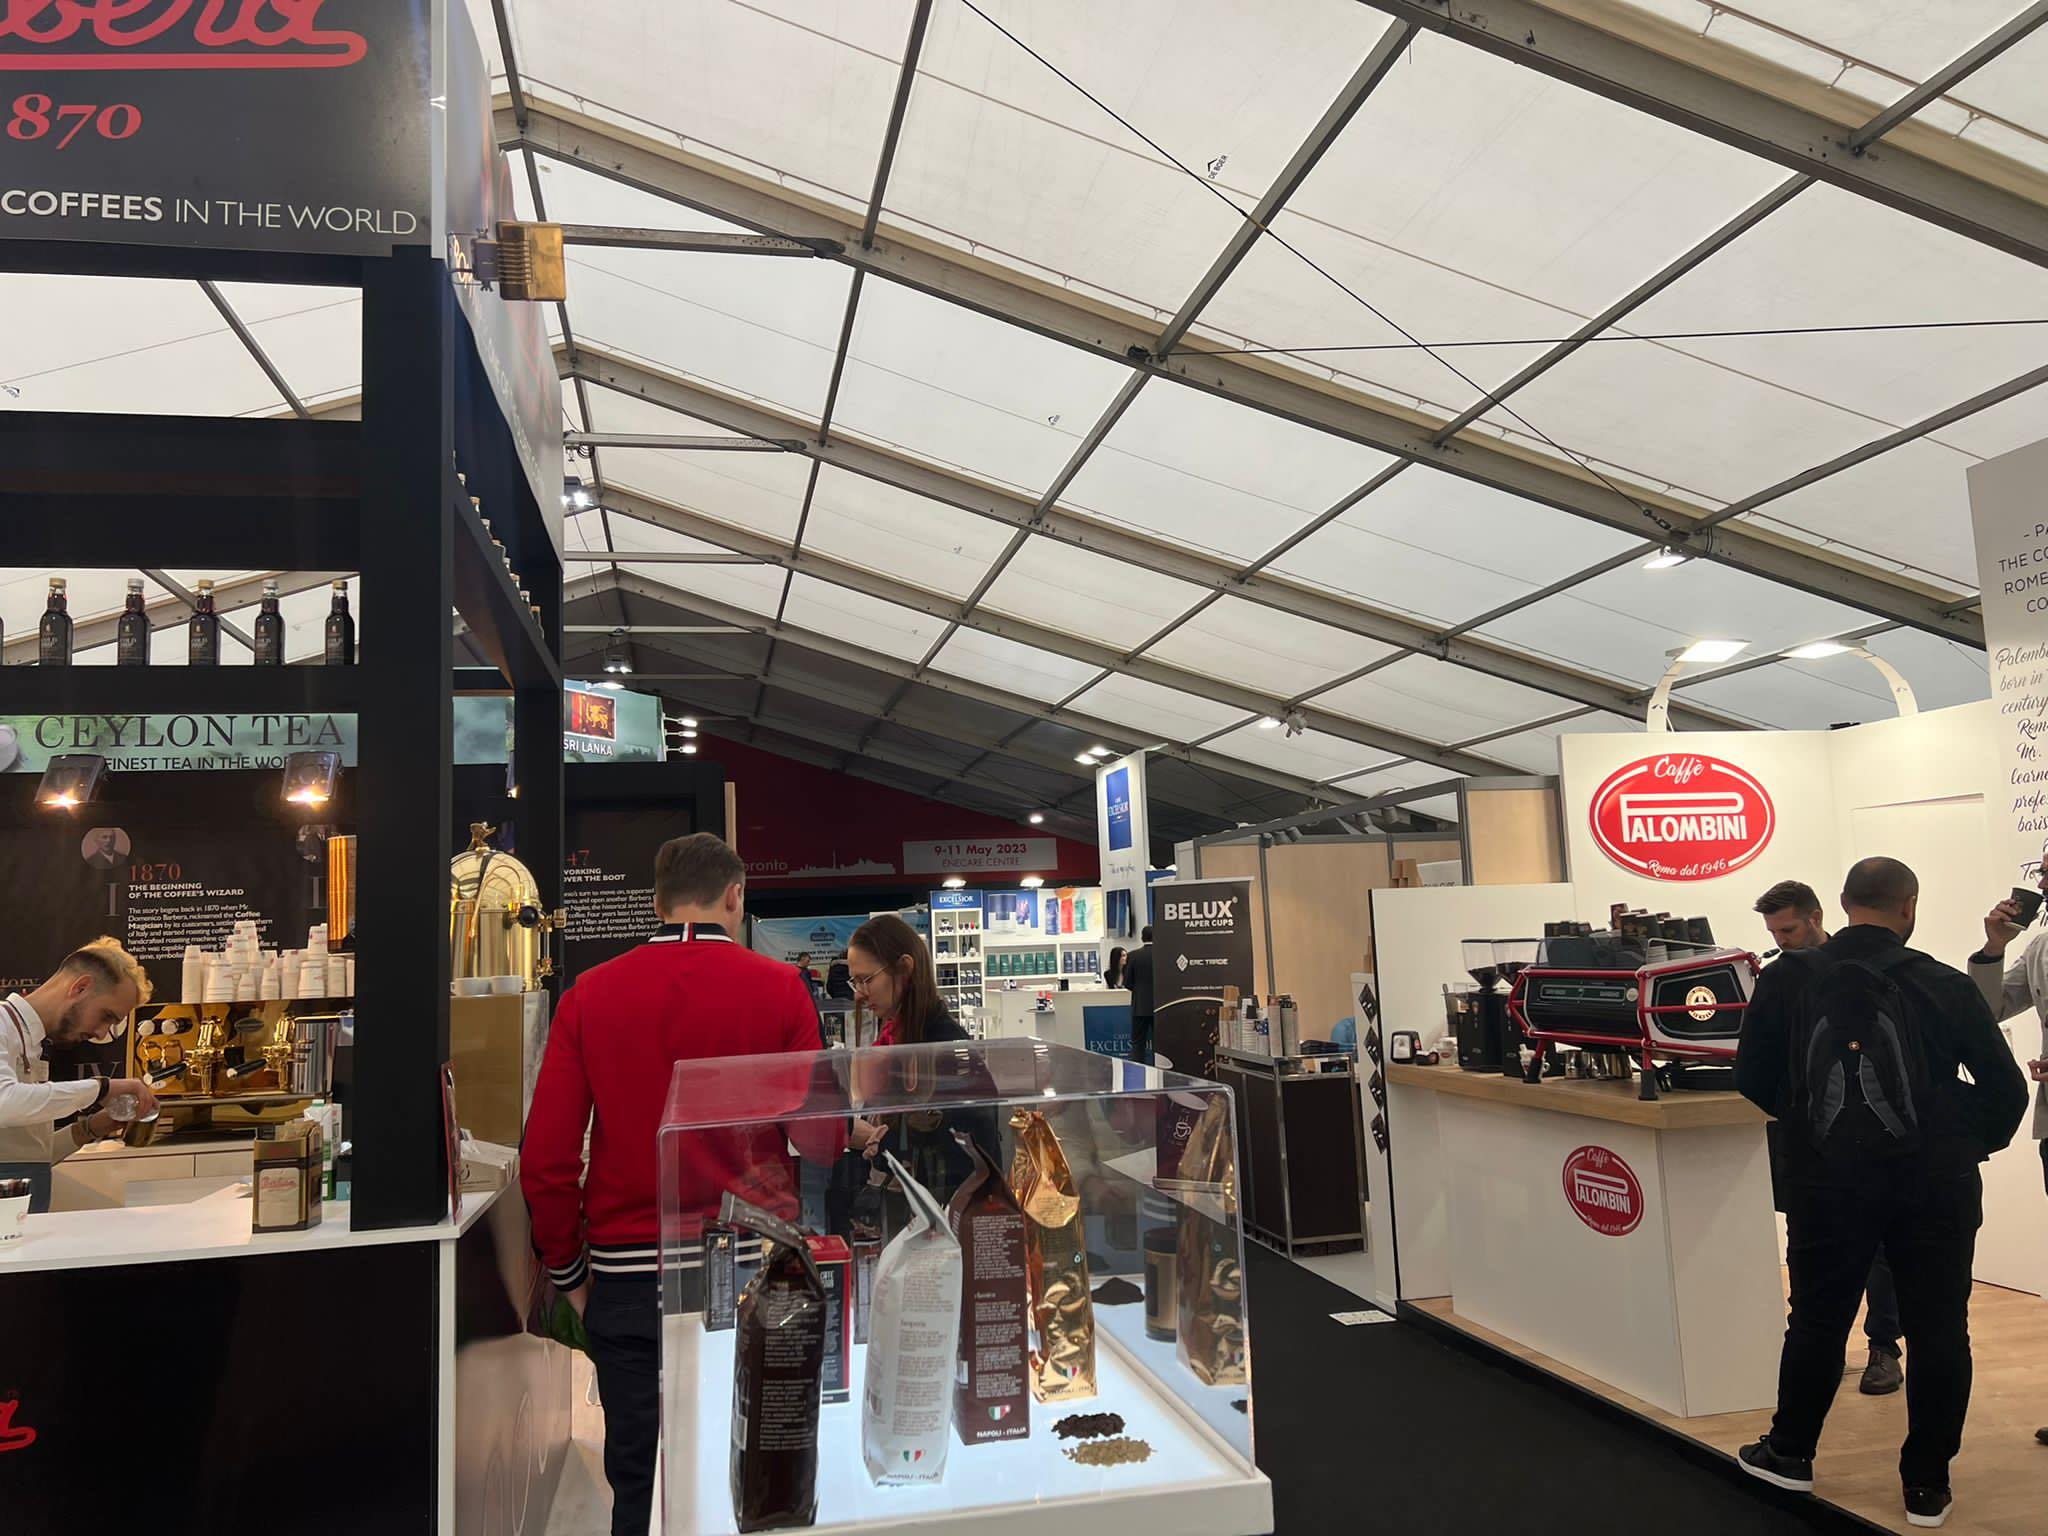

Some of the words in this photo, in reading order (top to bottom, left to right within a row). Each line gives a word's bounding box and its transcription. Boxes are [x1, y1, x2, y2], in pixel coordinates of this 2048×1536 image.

[7, 93, 142, 150] 870
[1, 190, 163, 222] COFFEES
[175, 199, 209, 225] IN
[216, 201, 281, 228] THE
[288, 205, 417, 235] WORLD
[1998, 553, 2028, 573] THE
[2000, 675, 2026, 692] born
[2031, 670, 2043, 686] in
[35, 714, 236, 750] CEYLON
[251, 714, 345, 747] TEA
[563, 738, 579, 750] SRI
[582, 741, 613, 756] LANKA
[104, 757, 157, 770] FINEST
[162, 757, 193, 770] TEA
[198, 757, 215, 769] IN
[220, 757, 250, 769] THE
[1654, 756, 1704, 784] Caffè
[1620, 791, 1747, 843] PALOMBINI
[966, 844, 992, 856] May
[997, 843, 1026, 854] 2023
[130, 863, 181, 881] 1870
[1680, 863, 1698, 876] dal
[1700, 859, 1727, 875] 1946
[150, 882, 202, 890] BEGINNING
[603, 873, 626, 881] BOOT
[128, 891, 142, 899] OF
[206, 888, 244, 896] WIZARD
[128, 923, 163, 931] Magician
[1574, 1169, 1631, 1214] PALOMBINI
